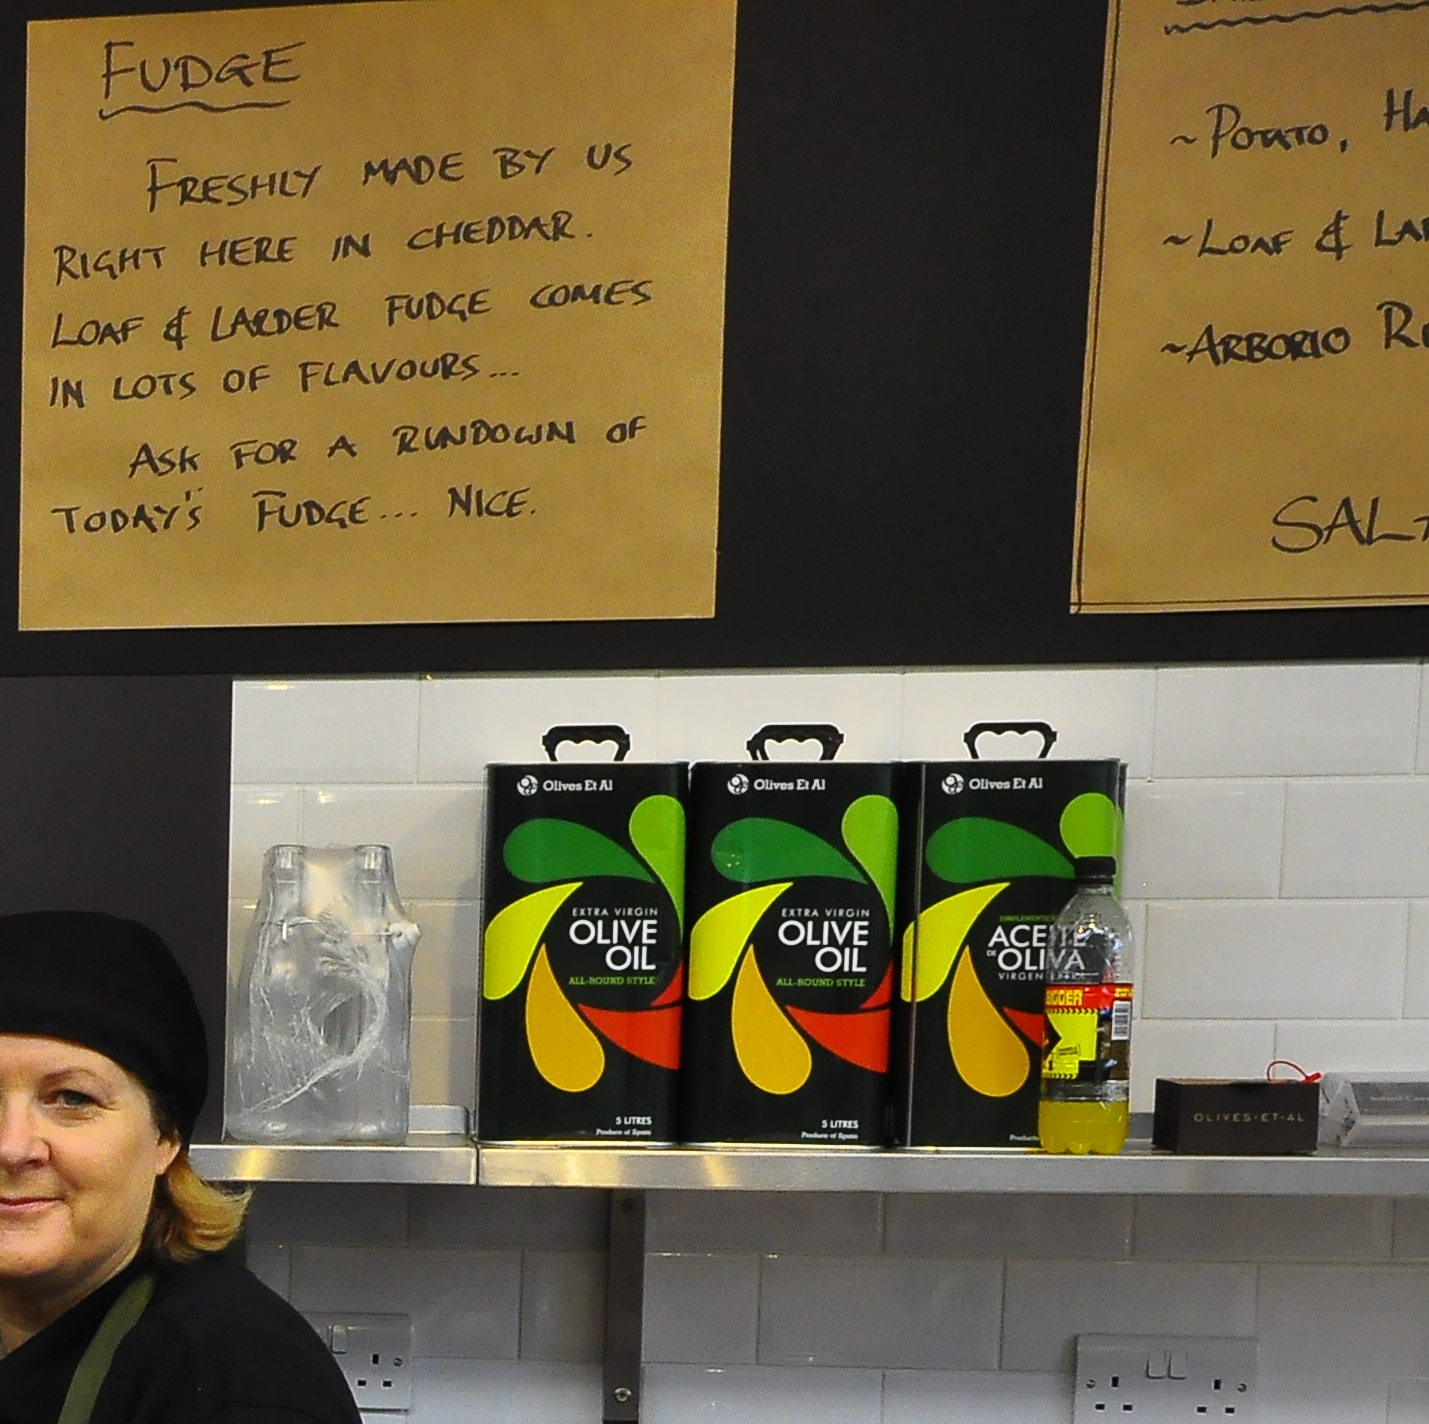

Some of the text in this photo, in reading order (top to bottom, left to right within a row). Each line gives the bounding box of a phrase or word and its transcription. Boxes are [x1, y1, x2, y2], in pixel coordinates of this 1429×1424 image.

[101, 40, 306, 100] FUDGE
[145, 142, 633, 213] FRESHLY MADE BY US
[53, 209, 594, 286] RIGHT HERE IN CHEDDAR.
[1197, 217, 1294, 258] LOAF
[51, 280, 654, 351] LOAF & LARDER FUDGE COMES
[49, 376, 86, 409] IN
[112, 370, 197, 402] LOTS
[222, 364, 271, 394] OF
[128, 415, 647, 480] ASK FOR A RUNDOWN OF
[51, 488, 204, 535] TODAY'S
[447, 484, 538, 520] NICE.
[543, 778, 613, 793] Olives Et Al
[572, 907, 658, 917] EXTRA VIRGIN
[781, 908, 870, 918] EXTRA VIRGIN
[569, 919, 658, 946] OLIVE
[778, 920, 869, 947] OLIVE
[605, 946, 657, 971] OIL
[814, 947, 868, 973] OIL
[997, 949, 1085, 970] OLIVA
[569, 976, 656, 986] ALL-ROUND STYLE
[998, 972, 1043, 980] VIRGEN
[624, 1116, 652, 1126] LITRES
